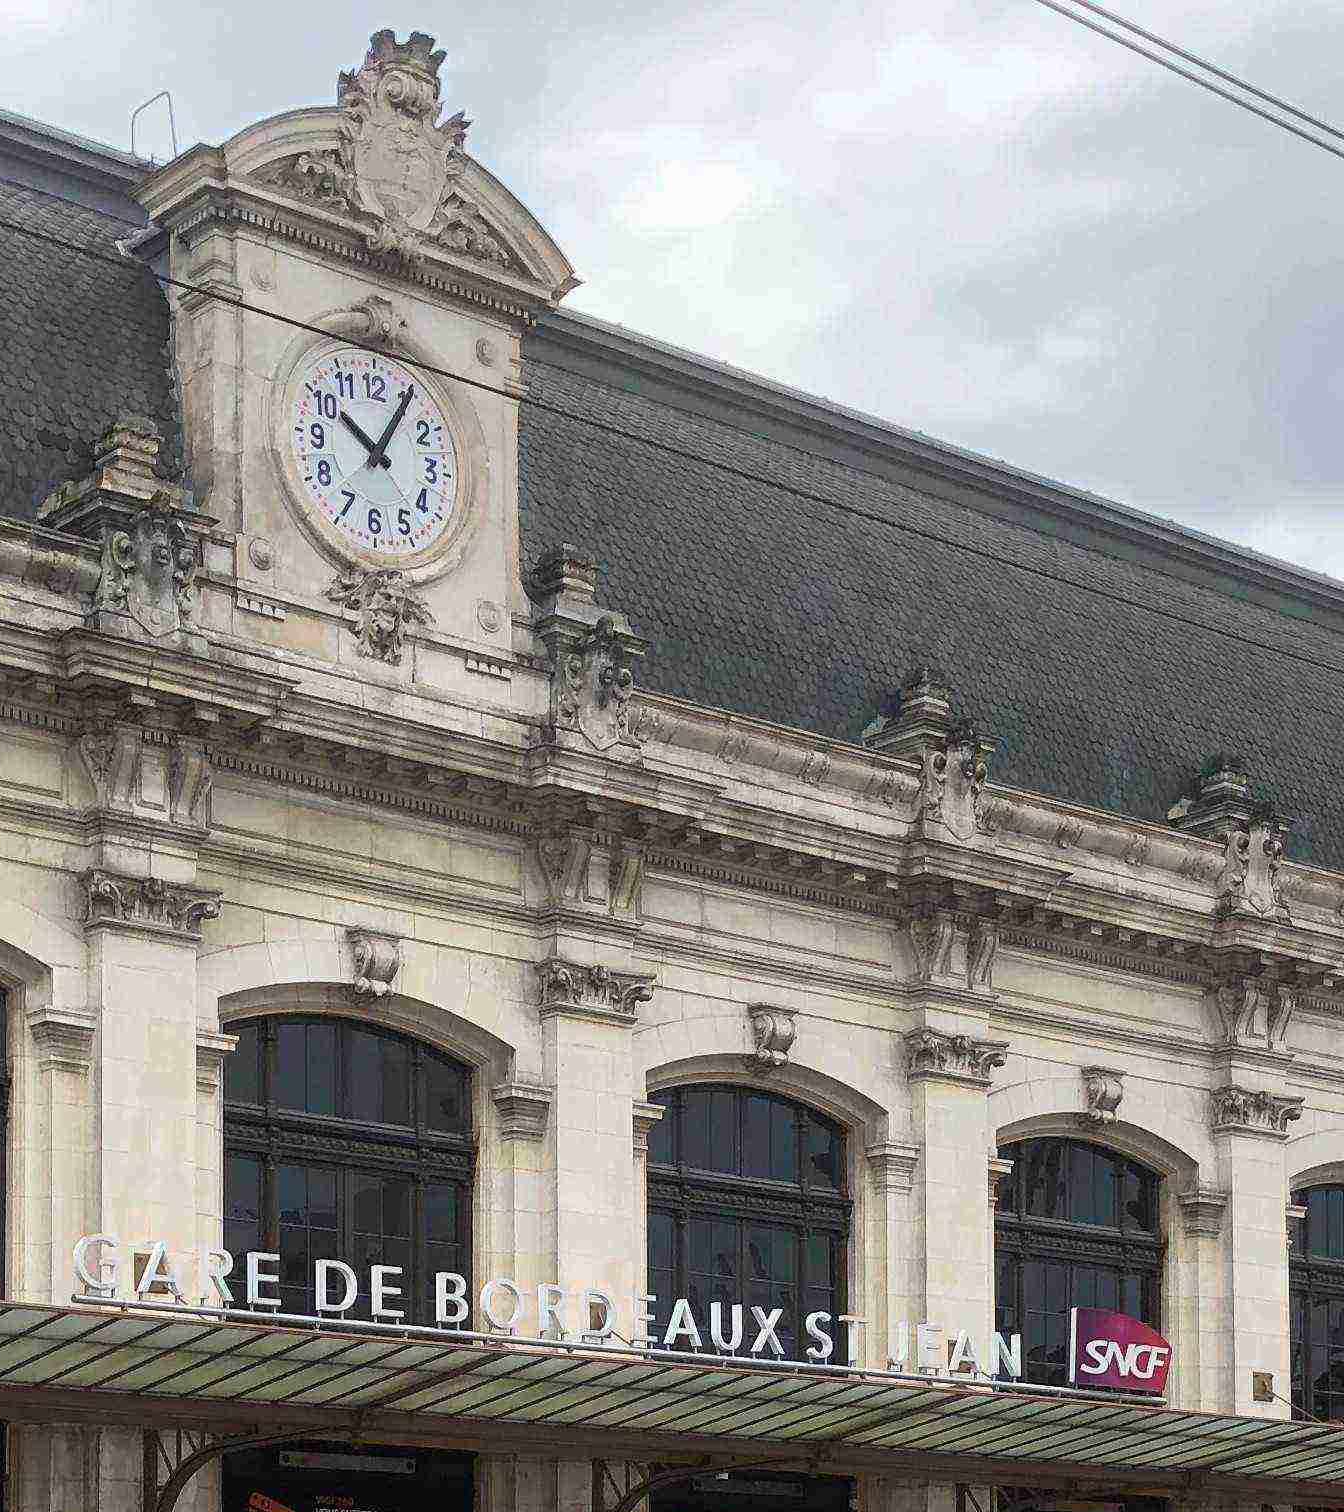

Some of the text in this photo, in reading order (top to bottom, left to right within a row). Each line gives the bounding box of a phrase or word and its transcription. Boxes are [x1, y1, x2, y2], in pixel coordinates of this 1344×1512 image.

[334, 371, 354, 400] 11
[362, 373, 387, 403] 12
[313, 389, 338, 420] 10
[310, 423, 325, 450] 9
[416, 420, 431, 447] 2
[317, 460, 332, 486] 8
[424, 457, 438, 484] 3
[340, 489, 355, 516] 7
[416, 488, 429, 514] 4
[367, 508, 382, 534] 6
[397, 508, 411, 535] 5
[73, 1233, 1022, 1377] GARE DE BORDEAUX ST JEAN
[1079, 1339, 1172, 1379] SNCF
